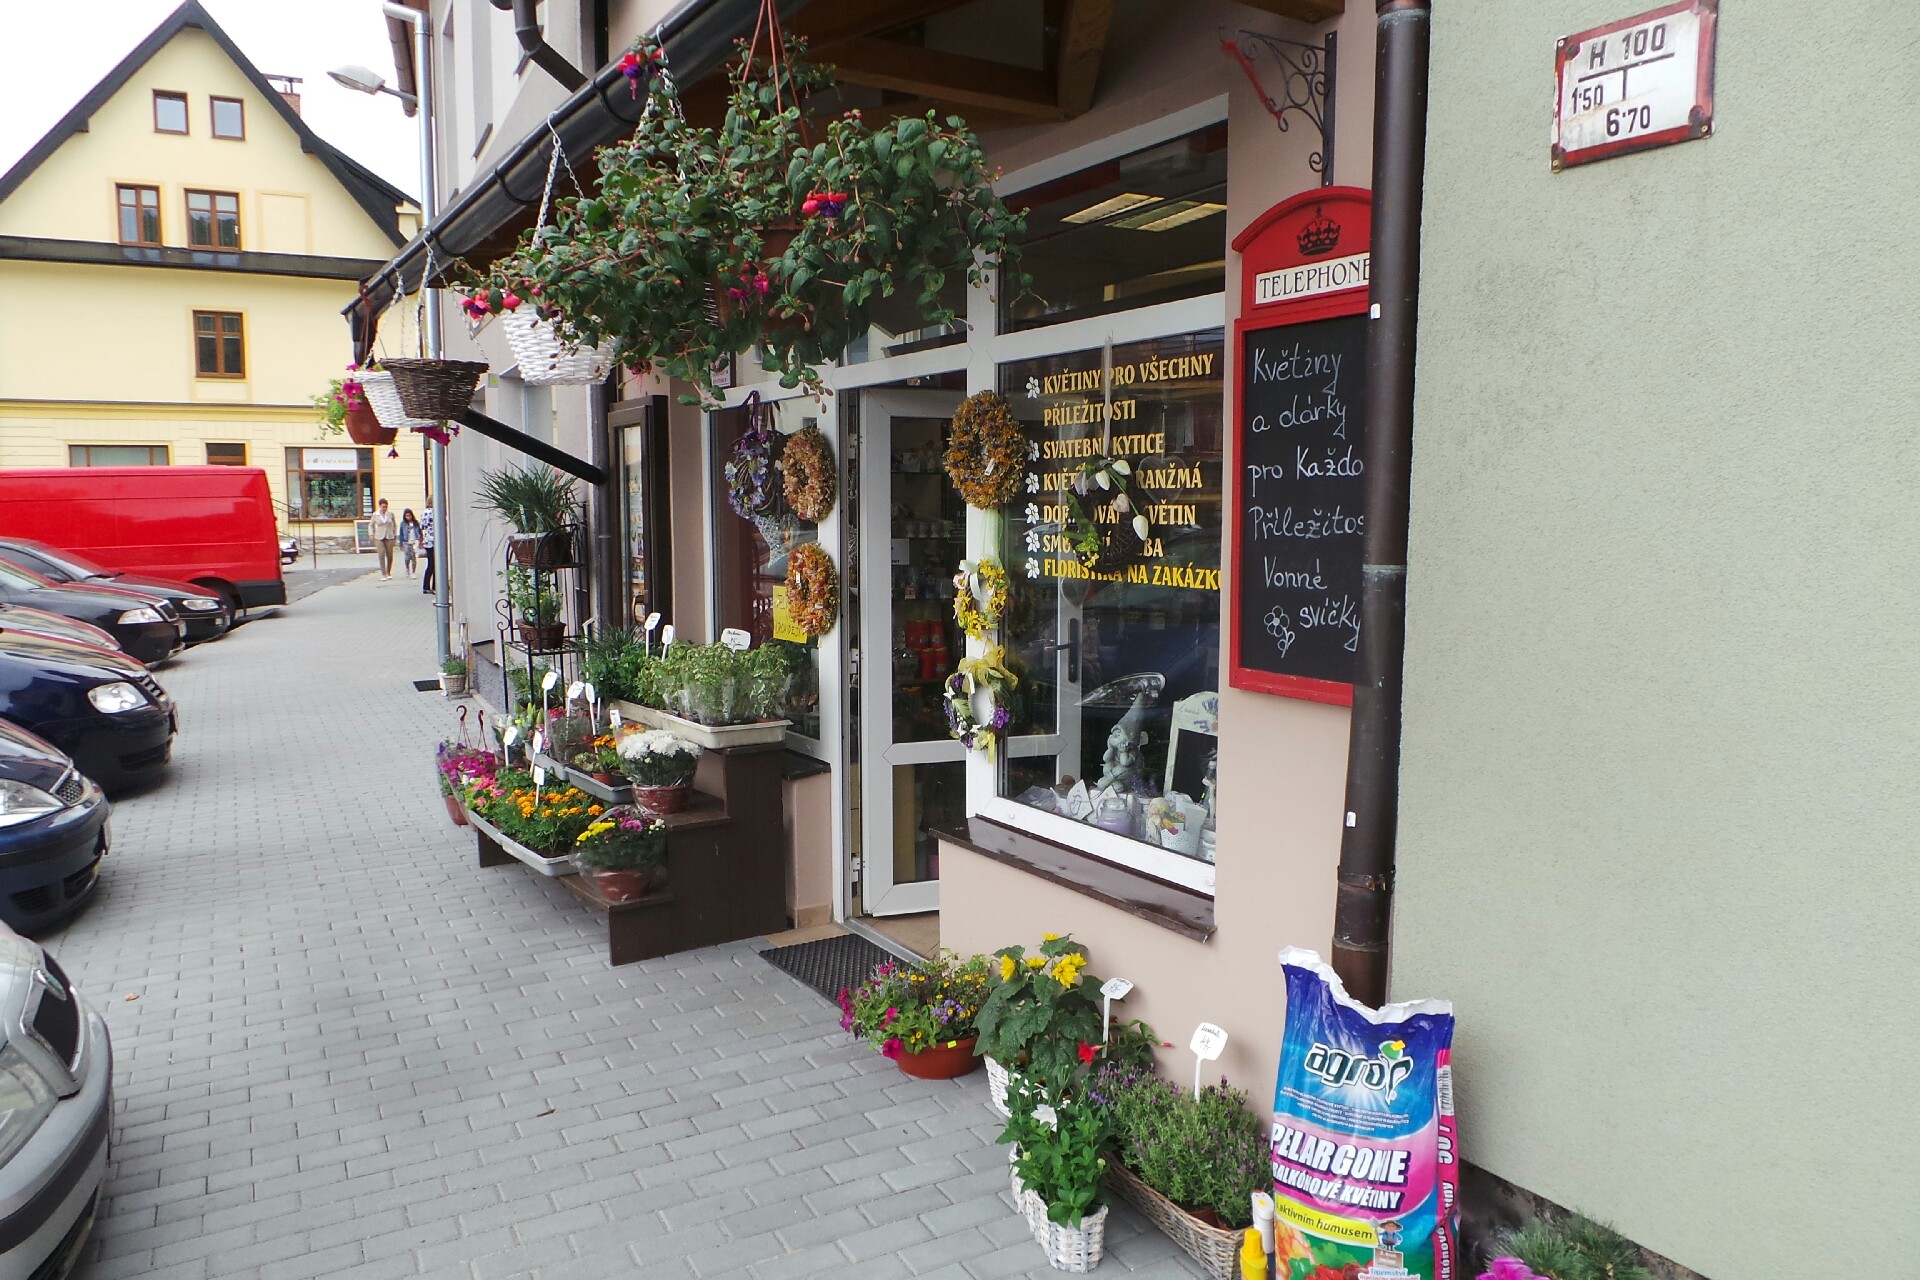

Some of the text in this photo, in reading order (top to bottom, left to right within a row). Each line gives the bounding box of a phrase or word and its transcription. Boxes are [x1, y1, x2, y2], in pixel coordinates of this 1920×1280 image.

[1589, 23, 1666, 70] H 100
[1259, 257, 1370, 298] TELEPHONE
[1043, 367, 1102, 394] KVĚTINY
[1139, 353, 1214, 383] VŠECHNY
[1253, 342, 1342, 396] Květiny
[1043, 398, 1136, 427] PŘÍLEŽITOSTI
[1252, 394, 1348, 440] a dárky
[1112, 432, 1165, 456] KYTICE
[1135, 461, 1203, 489] RANŽMÁ
[1247, 445, 1364, 498] pro Každo
[1144, 498, 1196, 525] VĚTIN
[1127, 565, 1148, 584] NA
[1264, 555, 1327, 590] Vonné
[1279, 1204, 1373, 1240] aktivním humusem
